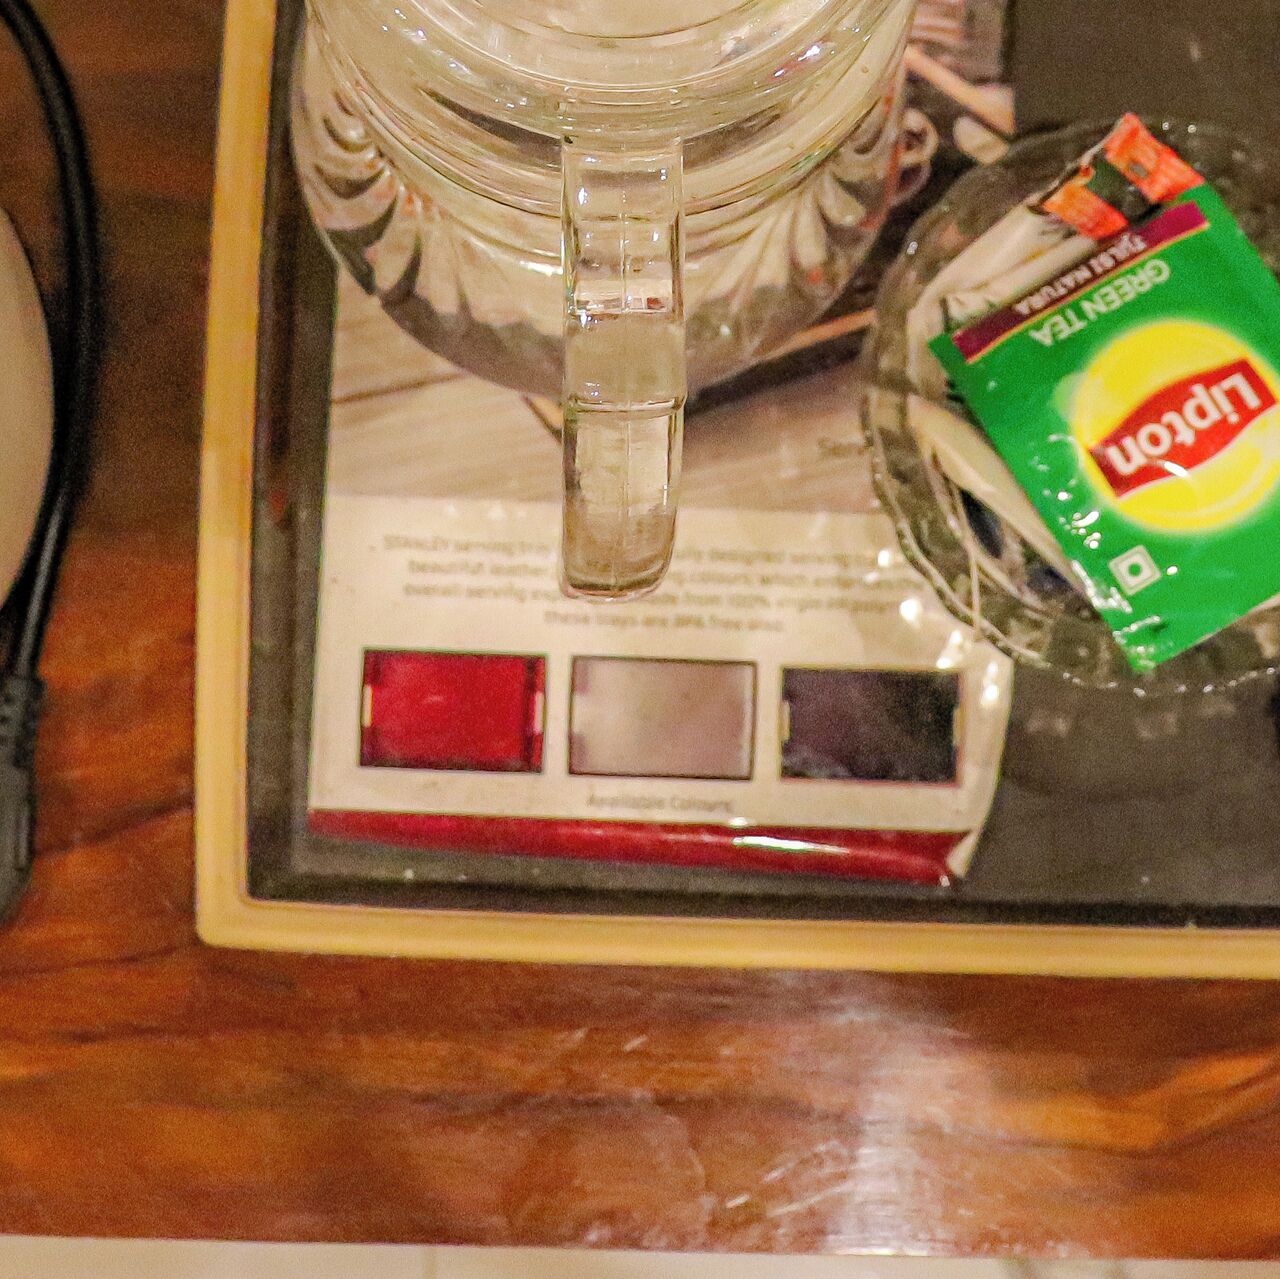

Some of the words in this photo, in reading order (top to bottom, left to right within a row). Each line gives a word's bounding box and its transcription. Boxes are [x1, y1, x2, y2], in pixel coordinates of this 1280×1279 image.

[1011, 264, 1092, 316] NATURA
[1080, 258, 1170, 321] GREEN
[1028, 308, 1088, 347] TEA
[1104, 371, 1262, 476] Lipton
